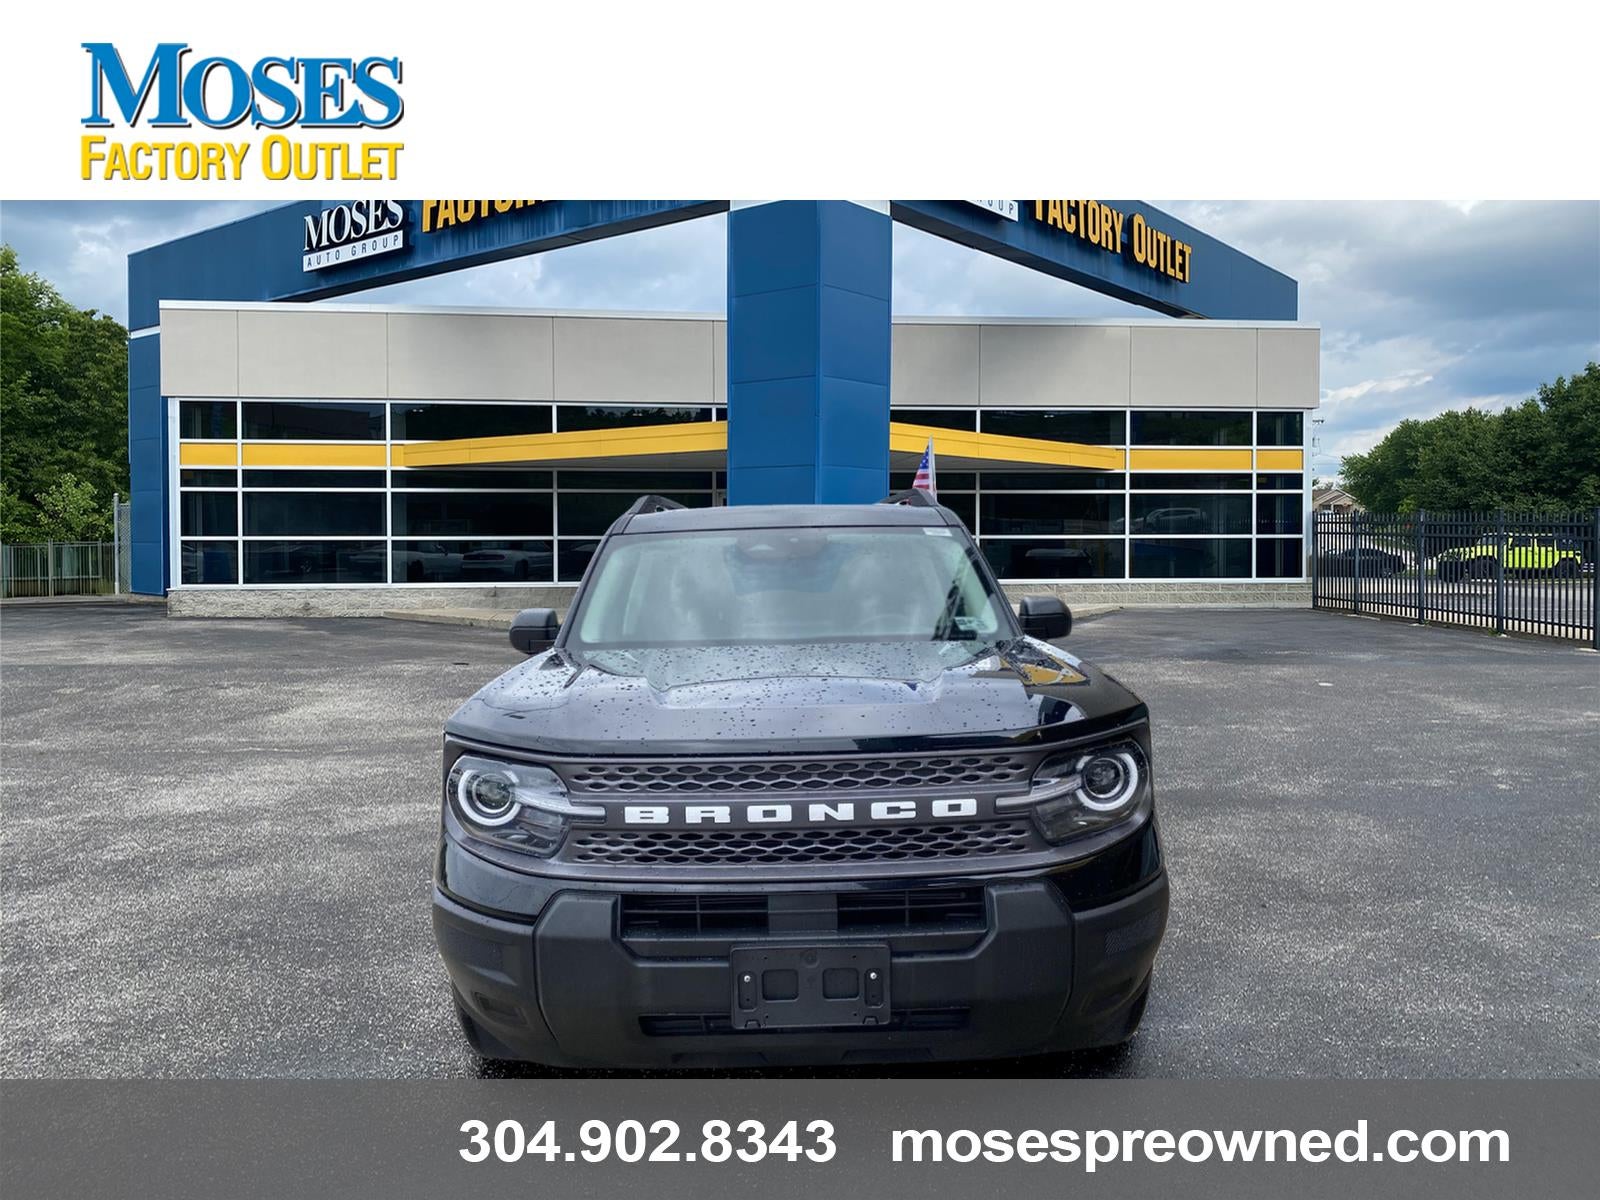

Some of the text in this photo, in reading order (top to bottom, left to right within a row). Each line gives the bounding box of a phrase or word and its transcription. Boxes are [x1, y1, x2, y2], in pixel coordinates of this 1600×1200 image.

[303, 200, 404, 251] MOSES
[307, 234, 399, 268] AUTO GROUP
[1133, 213, 1192, 283] OUTLET
[624, 798, 977, 824] BRONCO
